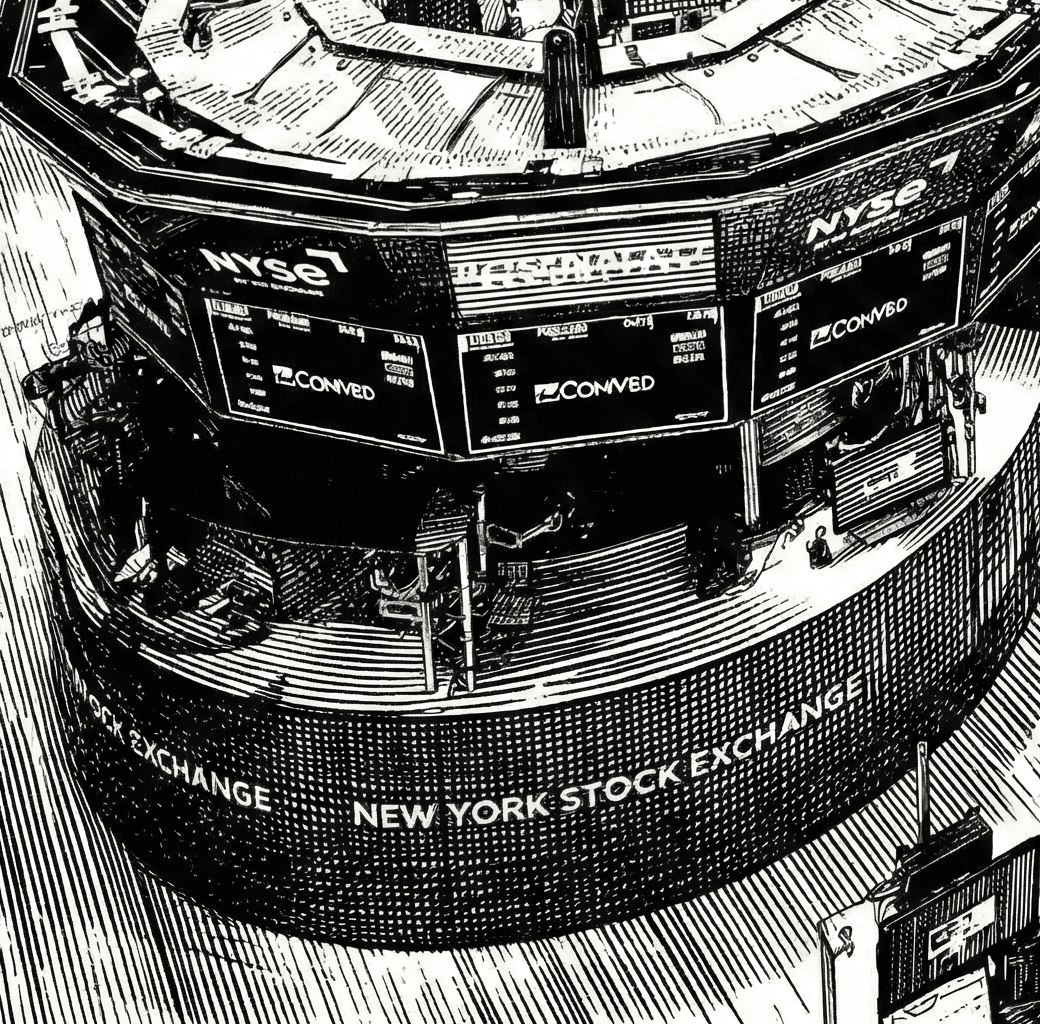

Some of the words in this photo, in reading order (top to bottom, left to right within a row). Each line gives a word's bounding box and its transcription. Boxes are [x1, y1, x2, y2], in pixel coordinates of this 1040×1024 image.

[353, 801, 438, 829] NEW
[448, 792, 548, 827] YORK
[560, 760, 682, 812] STOCK
[691, 674, 864, 778] EXCHANGE
